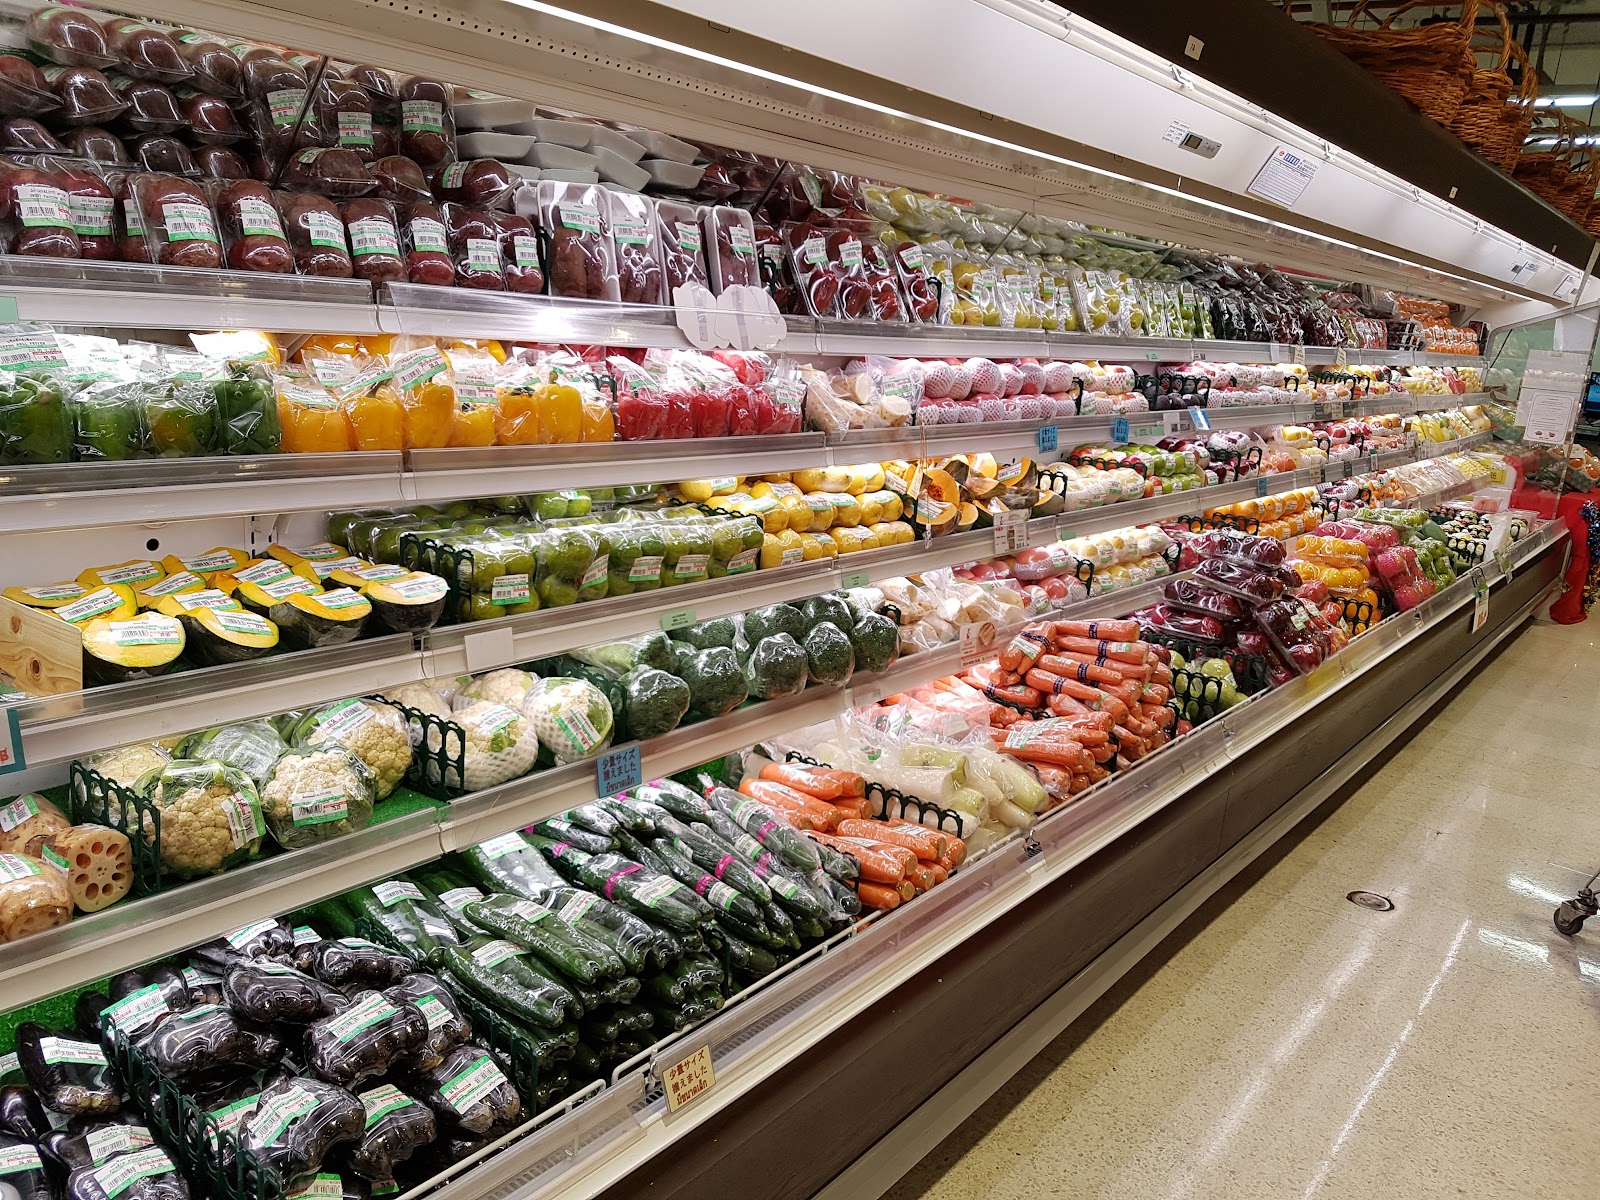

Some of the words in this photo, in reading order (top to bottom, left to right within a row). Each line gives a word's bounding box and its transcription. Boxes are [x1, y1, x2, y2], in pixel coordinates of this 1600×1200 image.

[669, 1049, 705, 1080] 少量サイズ
